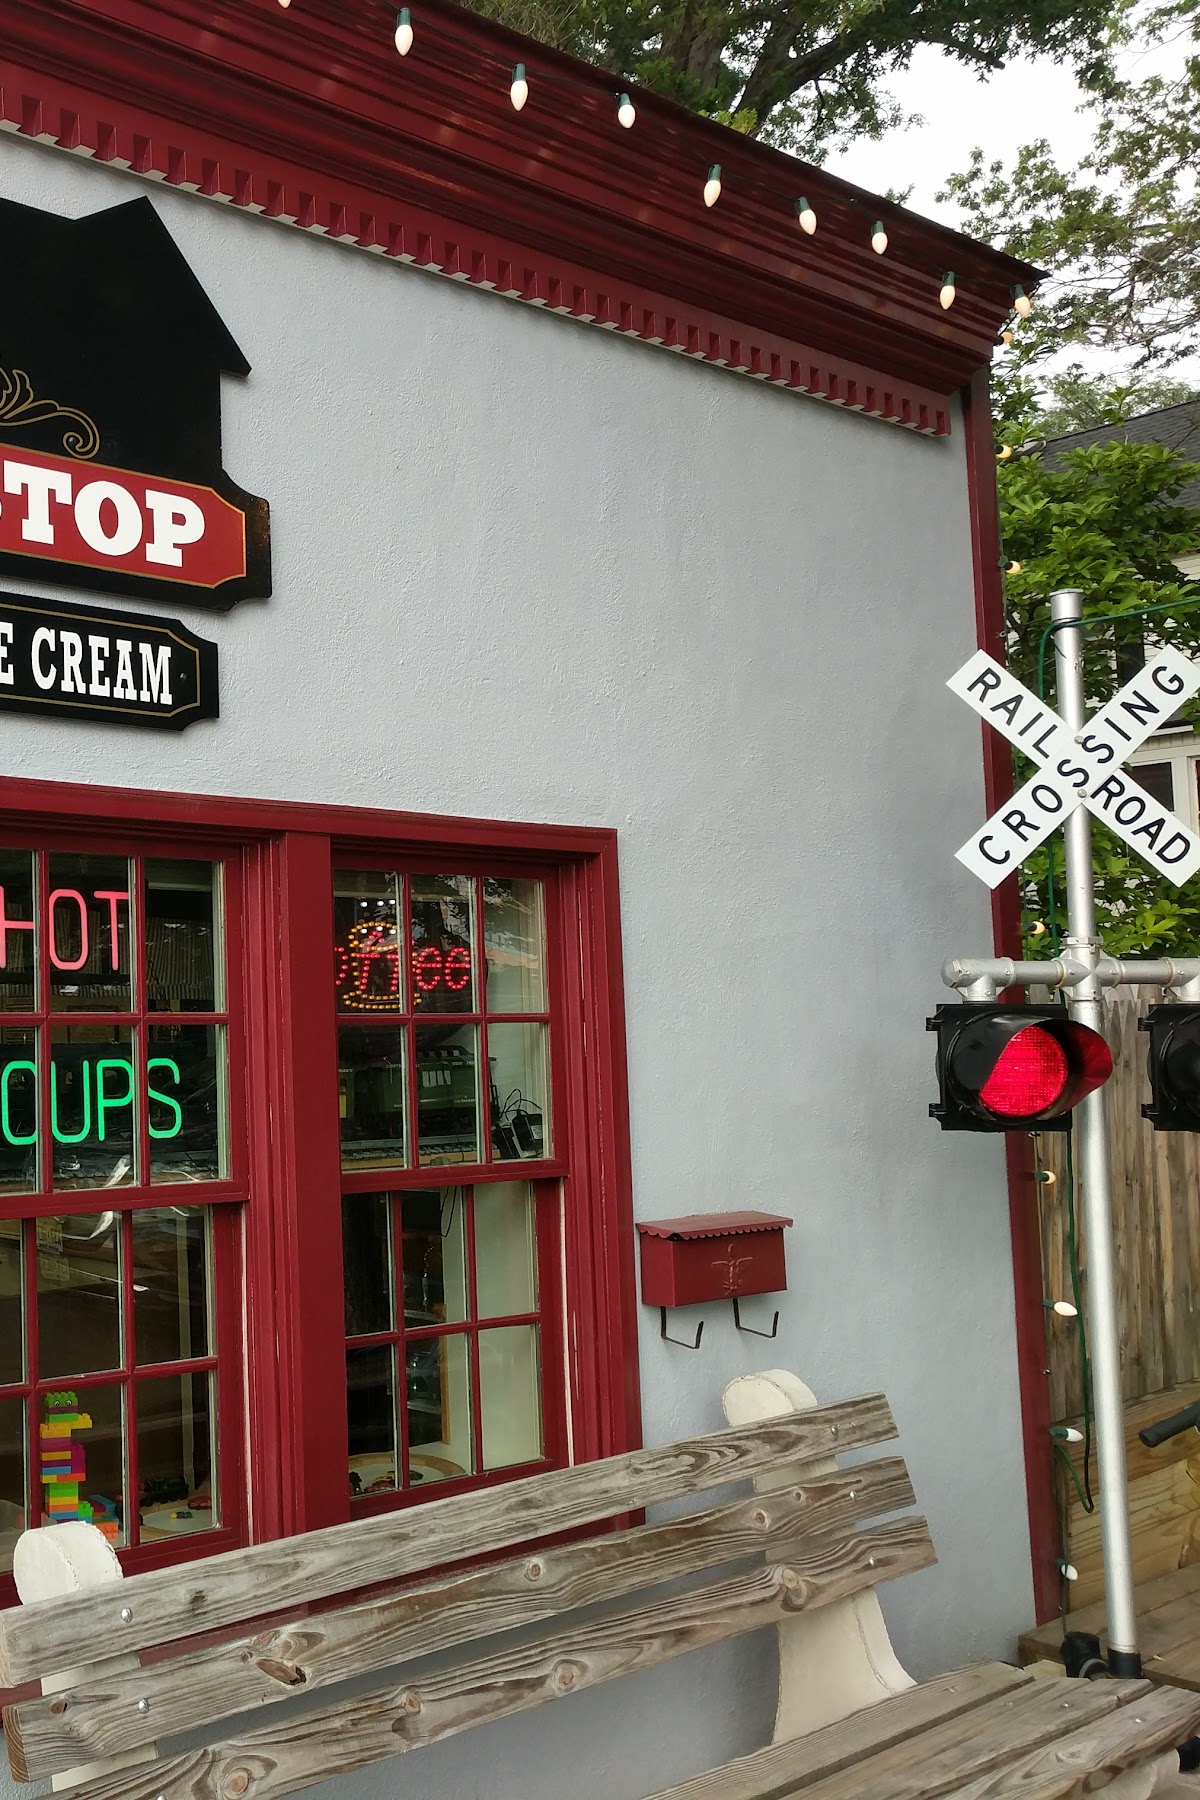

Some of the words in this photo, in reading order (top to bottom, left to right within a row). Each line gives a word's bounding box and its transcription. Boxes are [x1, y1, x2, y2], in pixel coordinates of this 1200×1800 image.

[31, 625, 173, 705] CREAM
[966, 667, 1058, 759] RAIL
[1090, 774, 1191, 864] ROAD
[978, 665, 1185, 865] CROSSING
